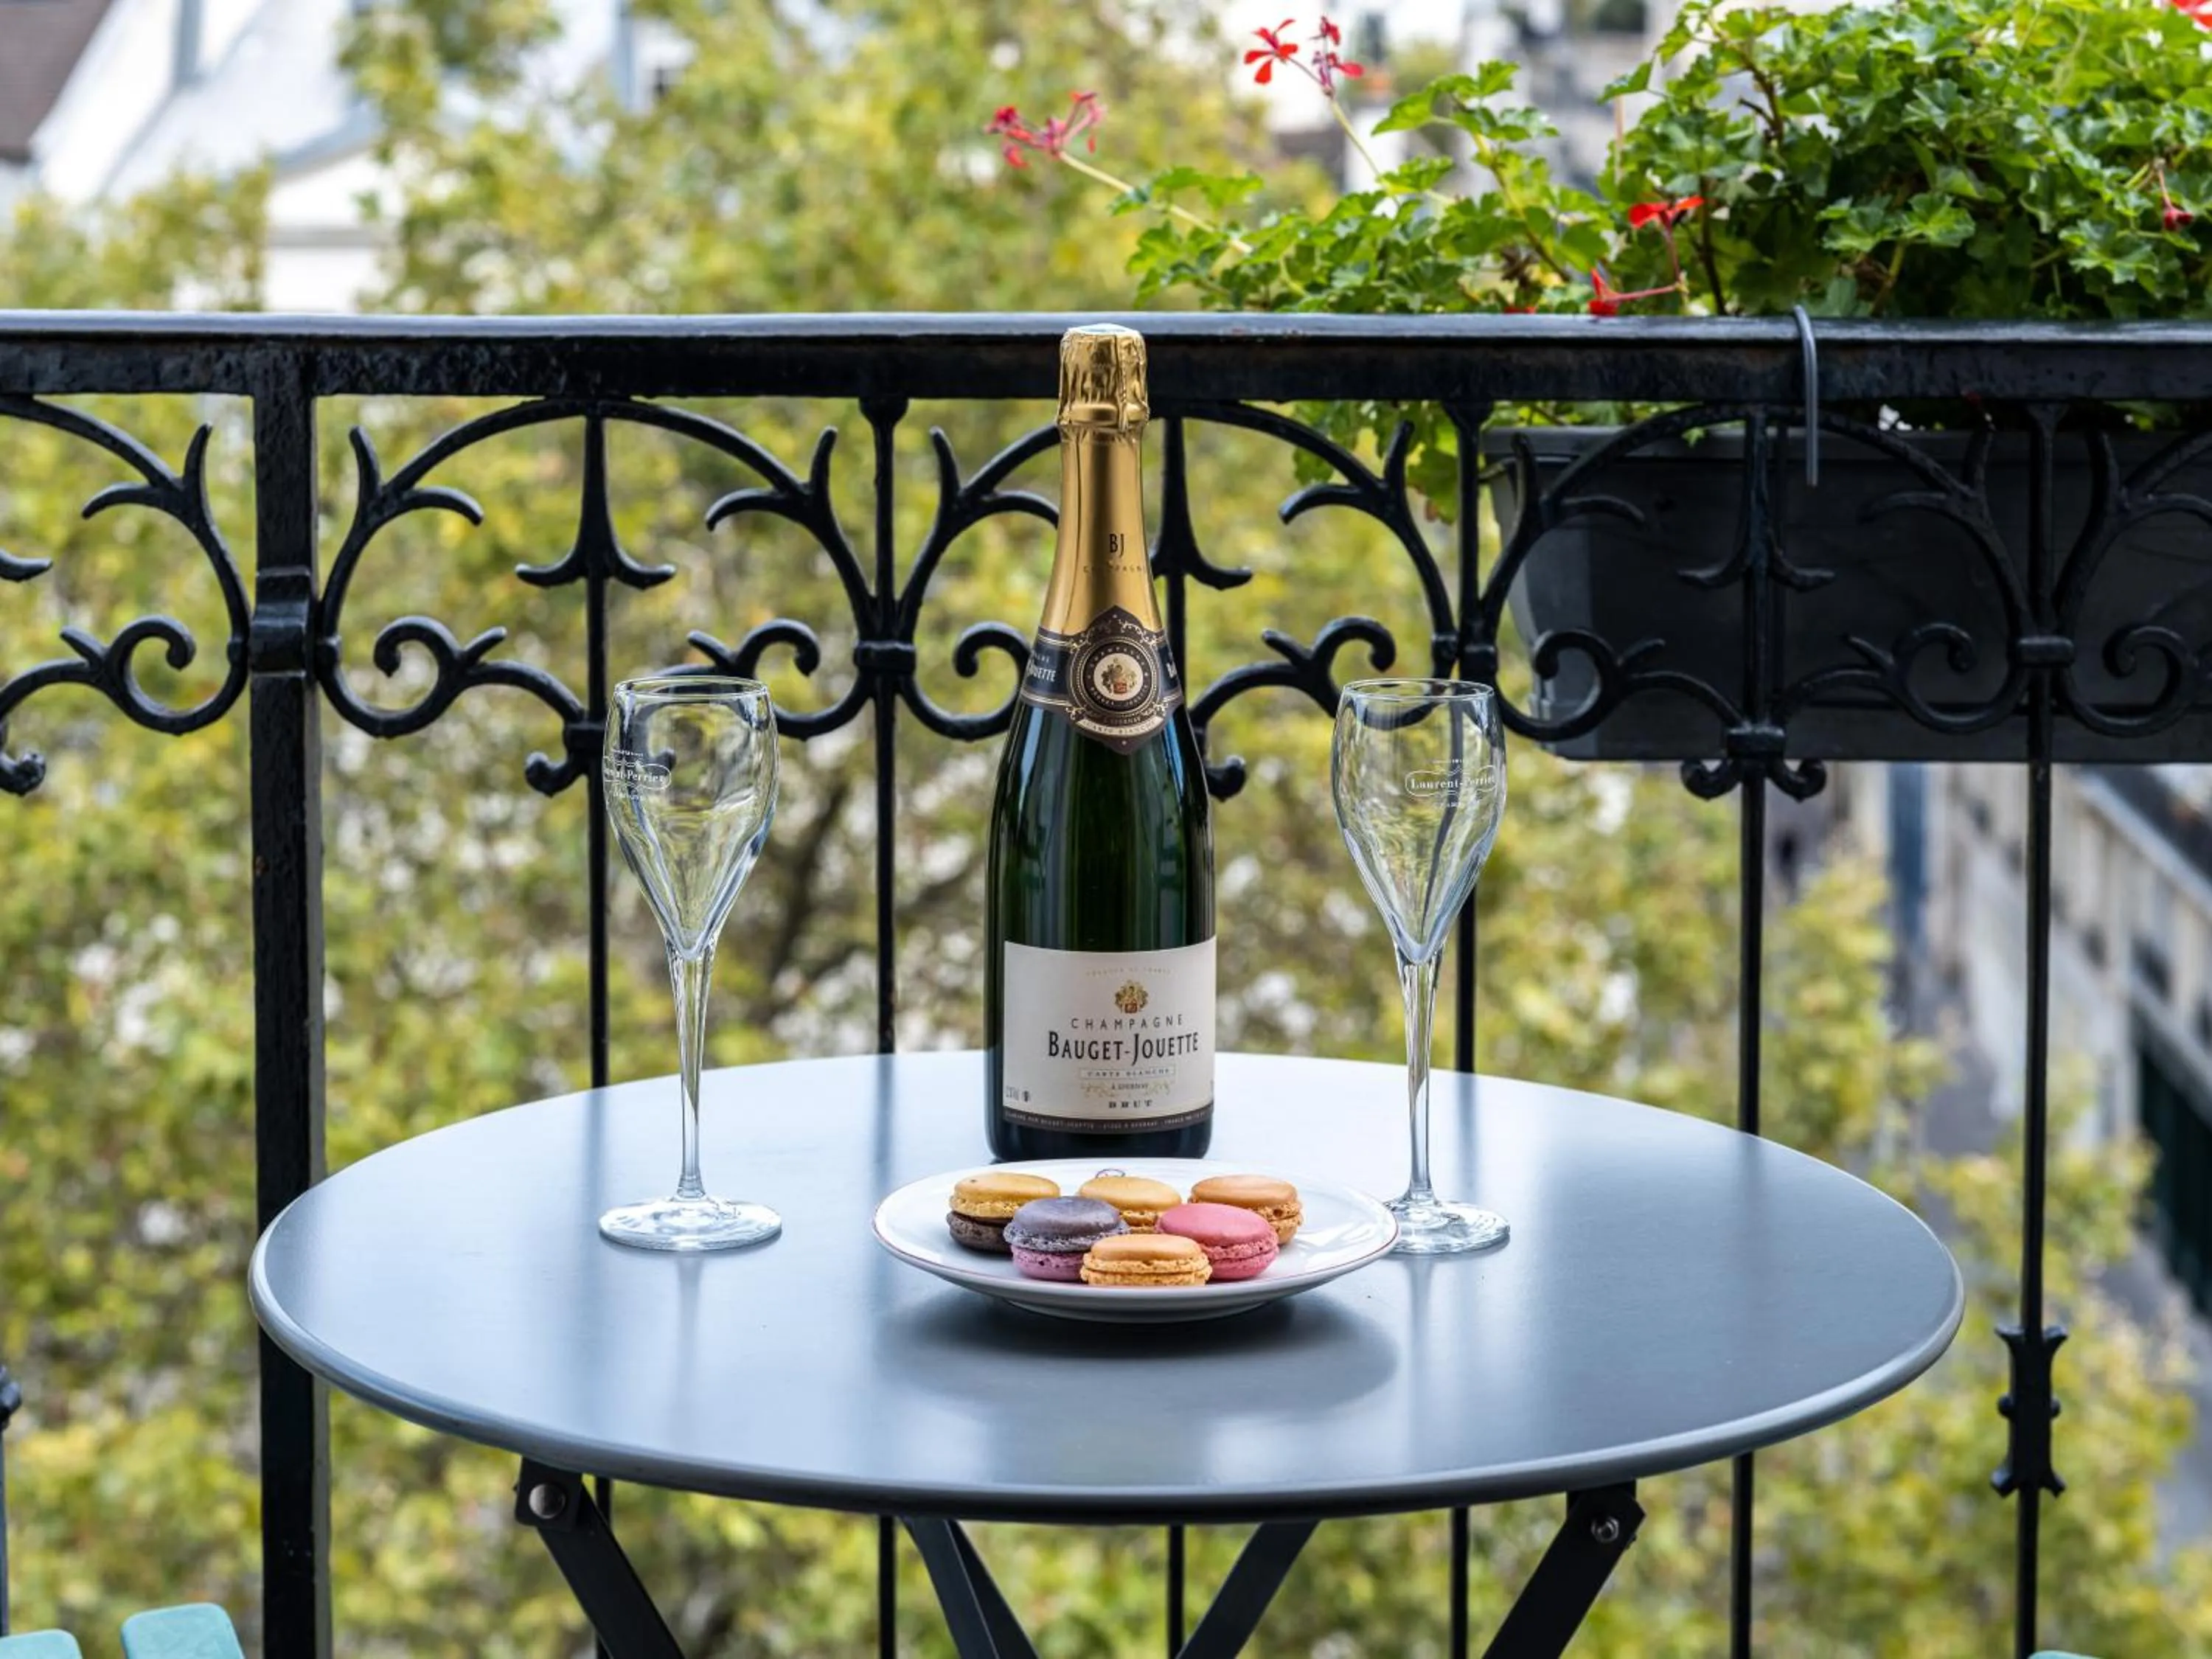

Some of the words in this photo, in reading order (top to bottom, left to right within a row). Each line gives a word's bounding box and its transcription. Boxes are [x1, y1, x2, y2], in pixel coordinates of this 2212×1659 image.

[1109, 533, 1125, 558] BJ
[1071, 1014, 1184, 1030] CHAMPAGNE
[1048, 1030, 1199, 1066] BAUGET-JOUETTE
[1109, 1099, 1152, 1108] BRUT
